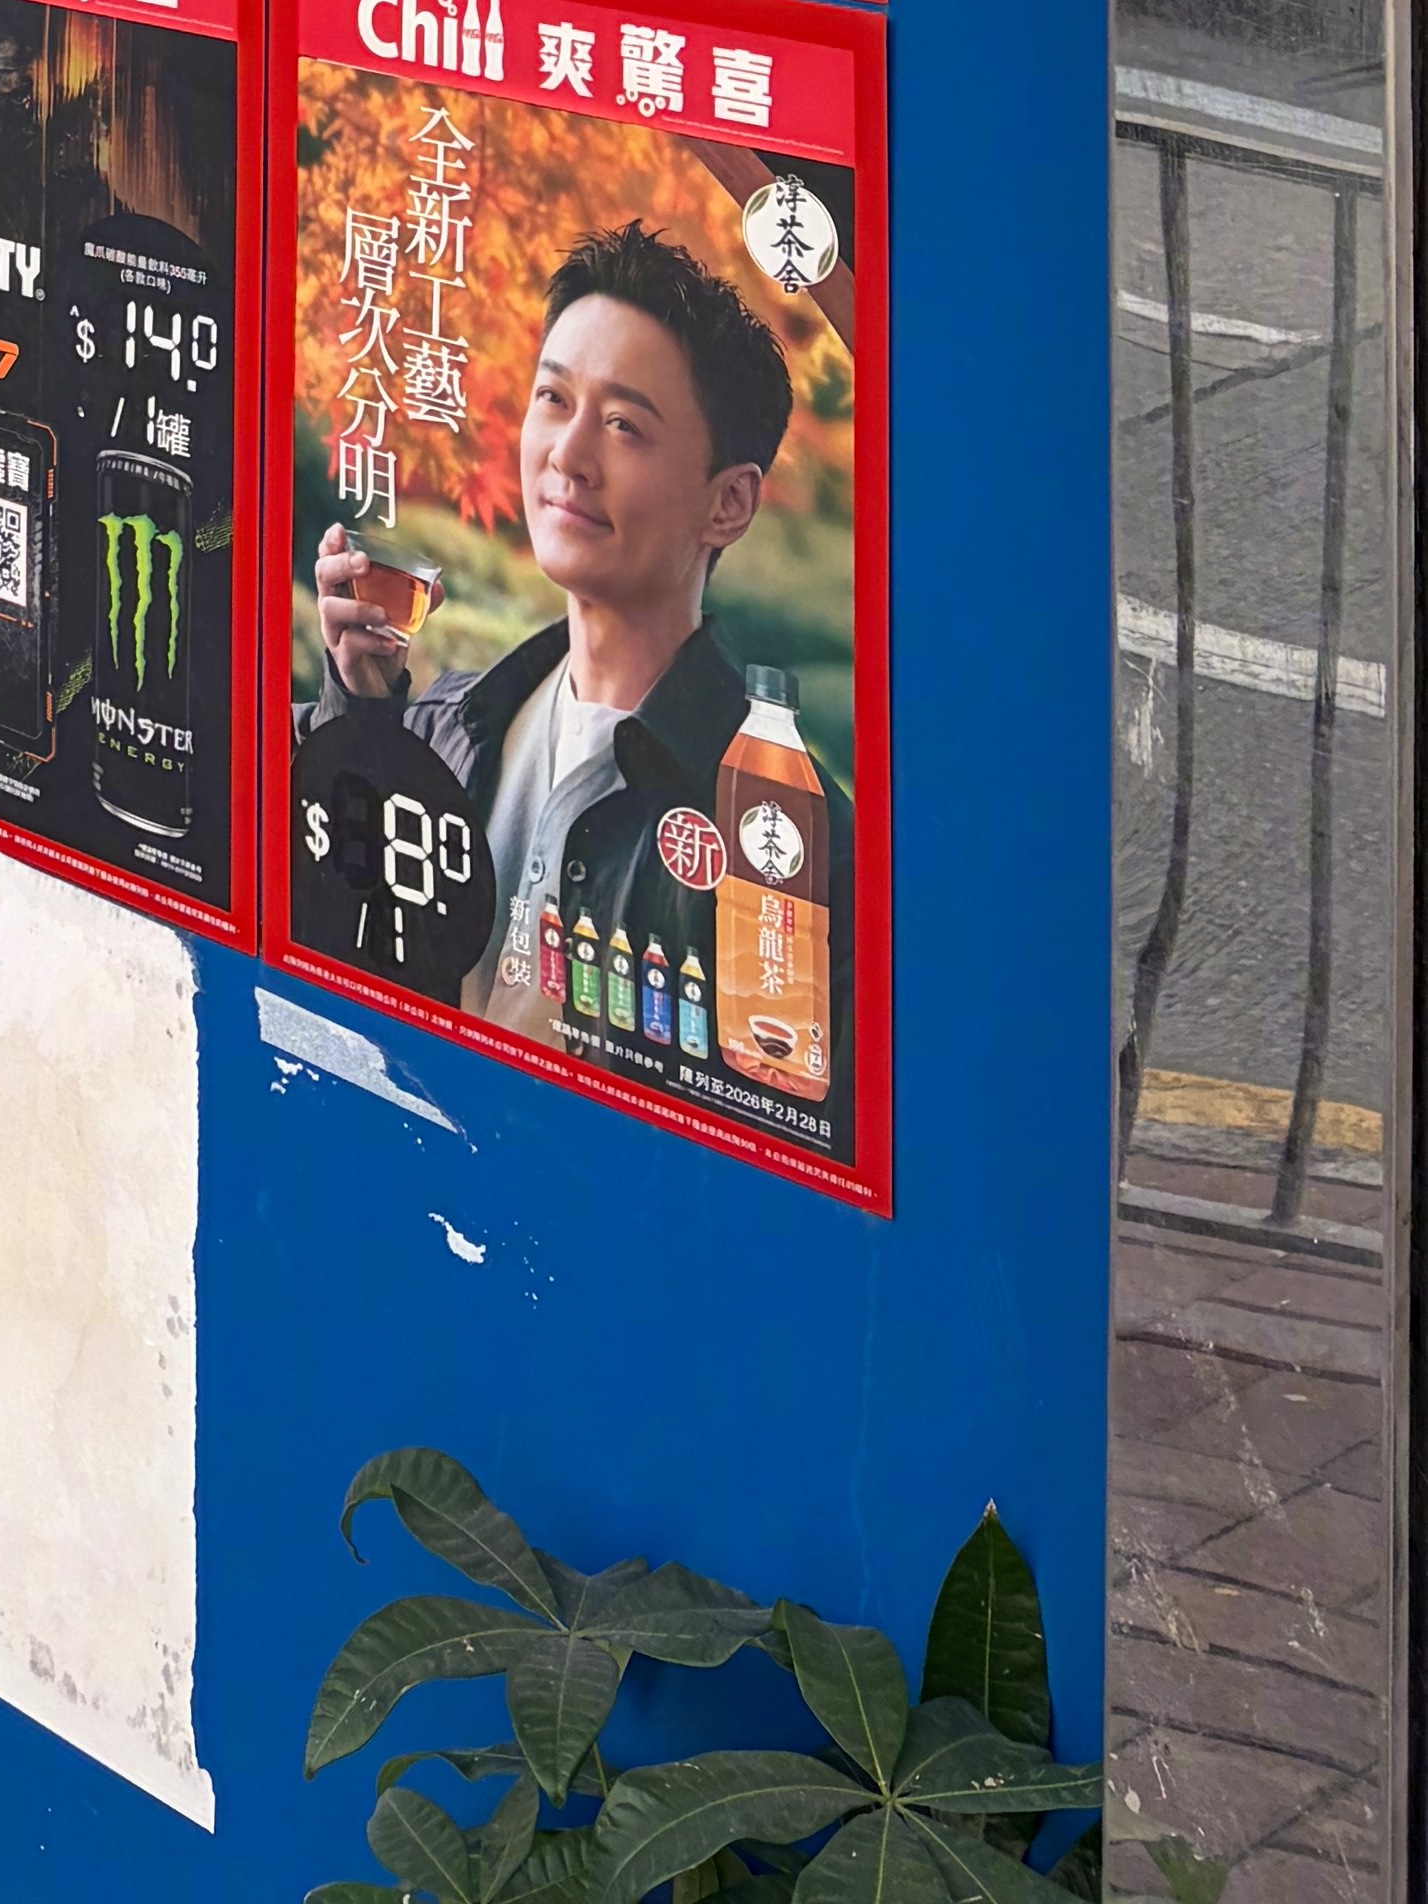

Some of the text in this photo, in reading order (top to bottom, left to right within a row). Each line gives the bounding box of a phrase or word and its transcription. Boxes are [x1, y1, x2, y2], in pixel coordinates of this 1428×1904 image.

[537, 21, 774, 129] 爽驚喜
[336, 205, 402, 530] 層次分明
[403, 105, 476, 434] 全新工藝
[757, 893, 785, 996] 烏龍茶
